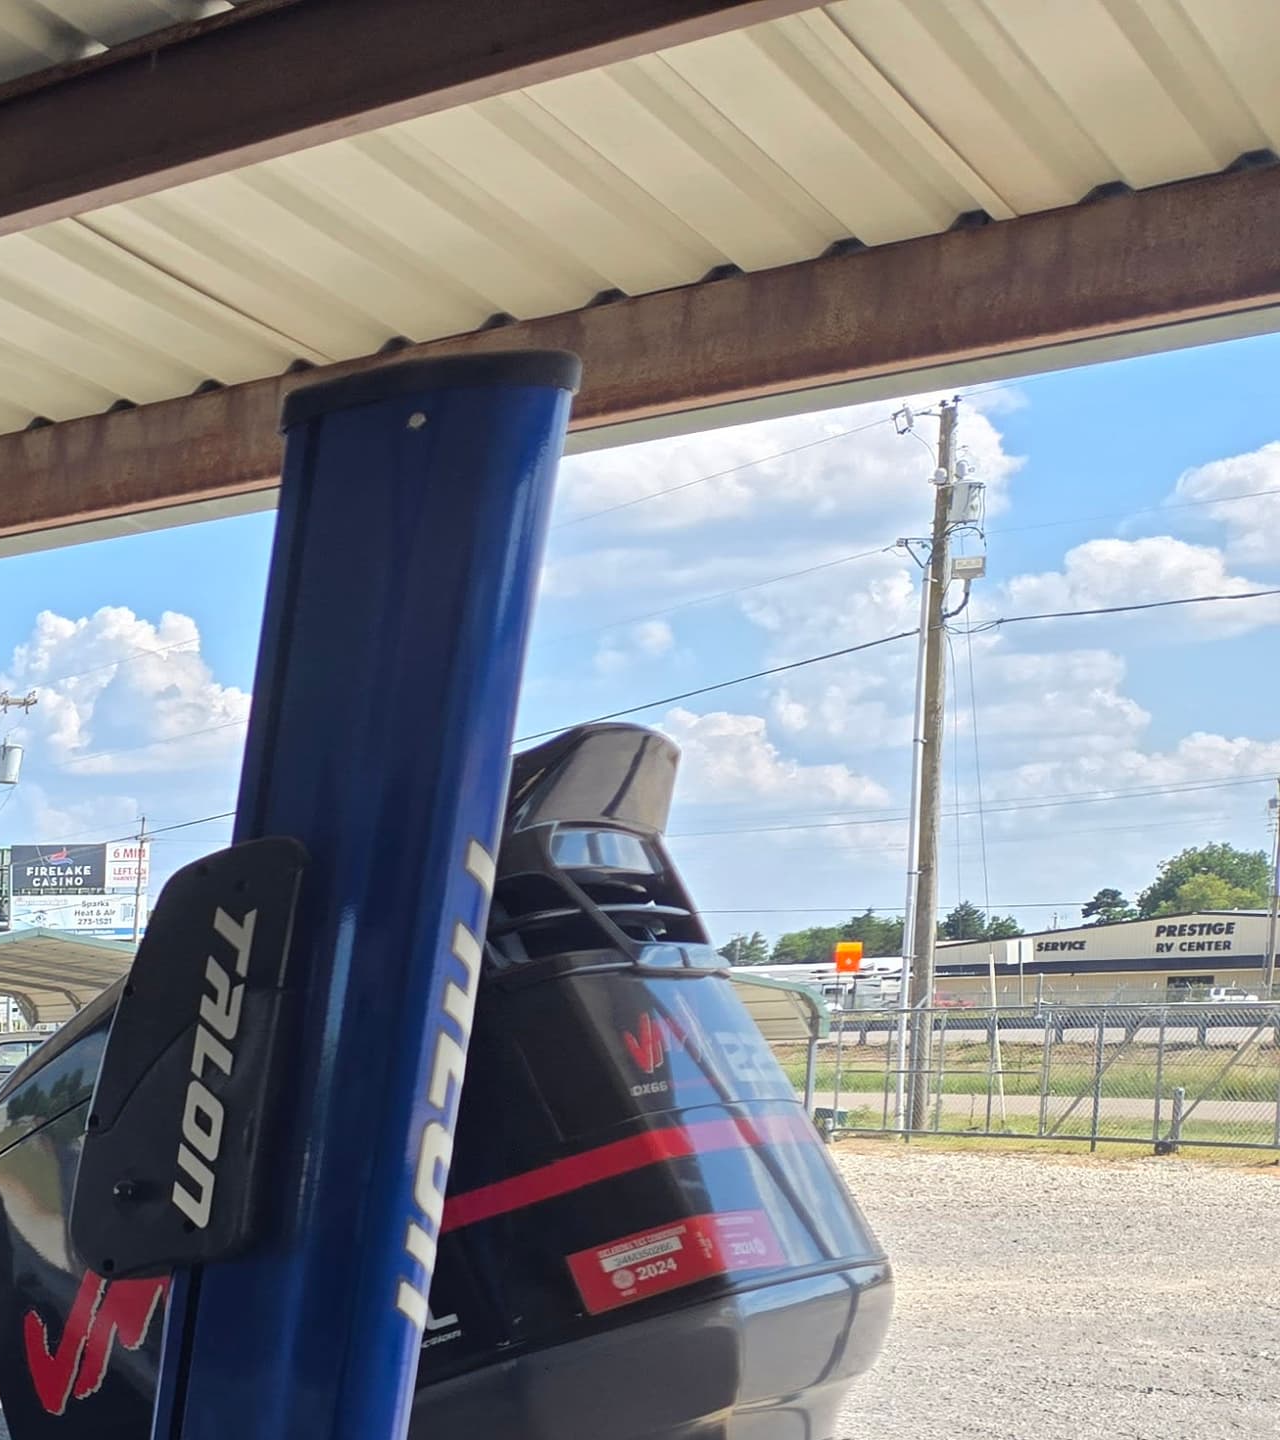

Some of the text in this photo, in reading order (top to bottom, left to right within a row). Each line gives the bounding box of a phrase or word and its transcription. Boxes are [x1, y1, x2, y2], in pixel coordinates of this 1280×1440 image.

[113, 848, 121, 858] 6
[26, 865, 91, 876] FIRELAKE
[32, 876, 84, 887] CASINO
[81, 900, 110, 909] Sparks
[74, 908, 116, 916] Heat & Air
[1155, 922, 1236, 938] PRESTIGE
[1036, 940, 1087, 952] SERVICE
[1156, 940, 1232, 953] RV CENTER
[172, 906, 258, 1229] TALON
[635, 1257, 679, 1281] 2024
